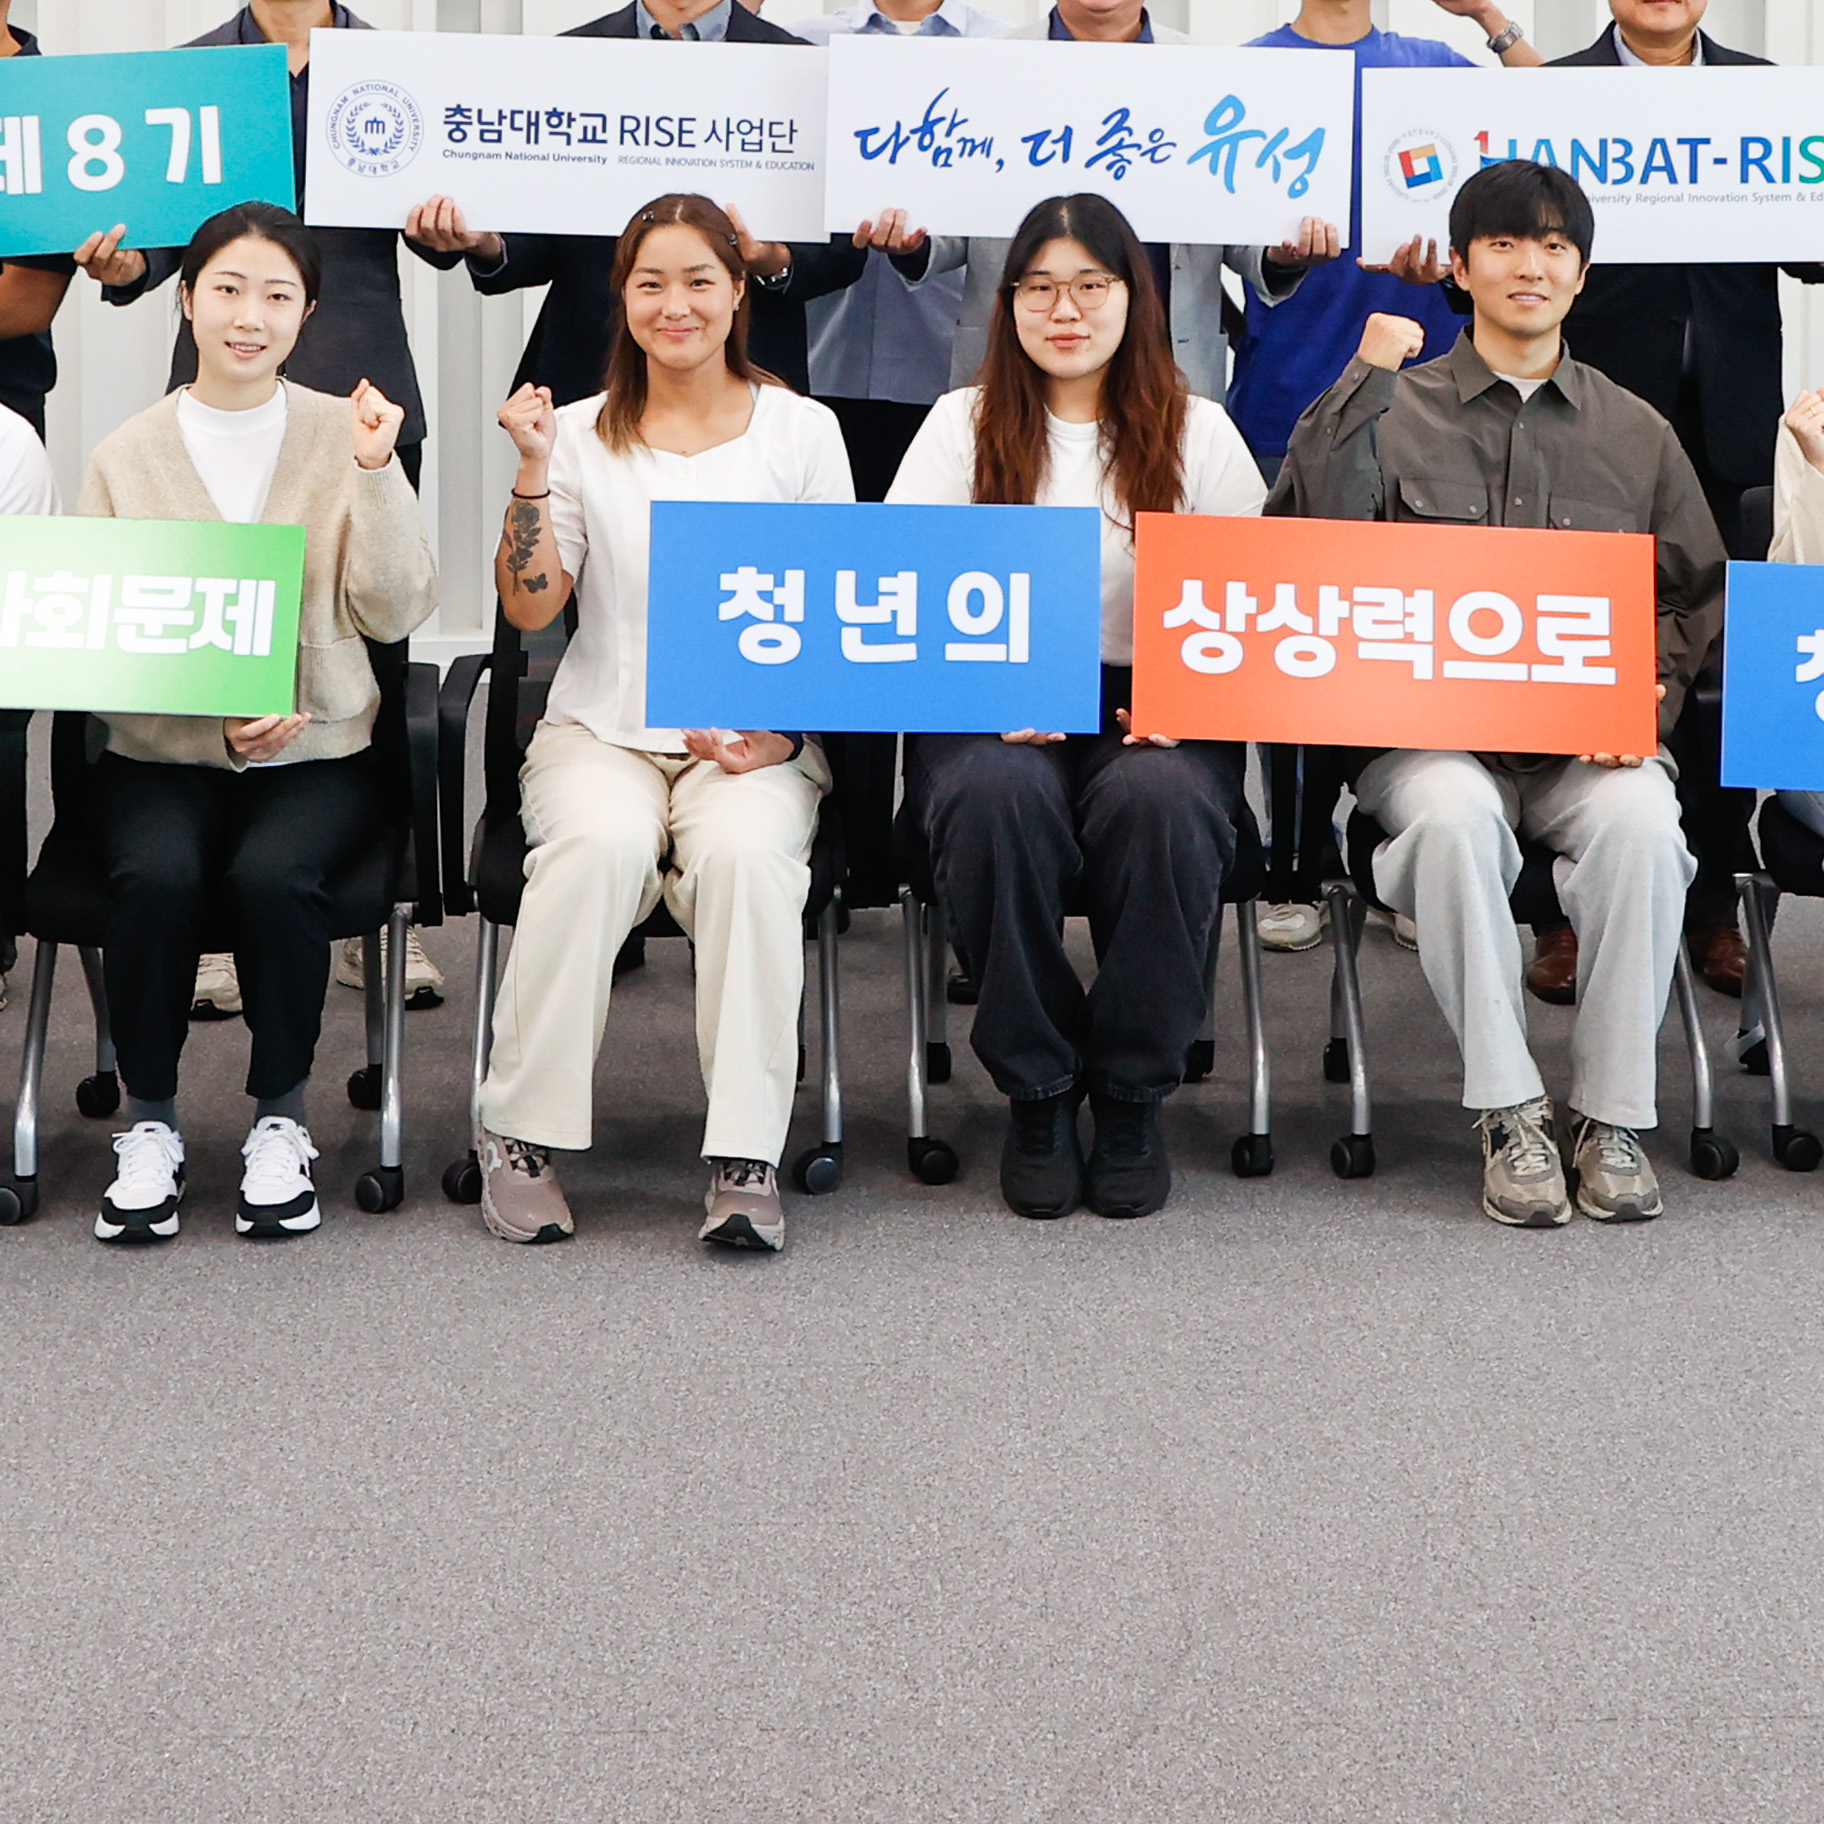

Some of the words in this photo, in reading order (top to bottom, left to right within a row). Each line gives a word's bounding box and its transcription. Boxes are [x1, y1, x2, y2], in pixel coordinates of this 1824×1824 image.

[330, 95, 349, 150] CHUNGNAM
[351, 83, 399, 97] NATIONAL
[401, 96, 421, 152] UNIVERSITY
[442, 103, 609, 147] 충남대학교
[619, 114, 698, 149] RISE
[703, 116, 799, 154] 사업단
[442, 148, 502, 161] Chungnam
[504, 151, 550, 162] National
[552, 153, 608, 165] University
[617, 155, 662, 166] REGIONAL
[665, 157, 717, 168] INNOVATION
[719, 159, 753, 169] SYSTEM
[755, 160, 763, 169] &
[765, 161, 815, 172] EDUCATION
[1020, 124, 1074, 167] 더
[1084, 107, 1178, 181] 좋은
[1186, 93, 1327, 200] 유성
[1635, 192, 1685, 205] Regional
[1687, 192, 1749, 204] Innovation
[1751, 191, 1793, 205] System
[1795, 191, 1807, 202] &
[1161, 577, 1619, 686] 상상력으로
